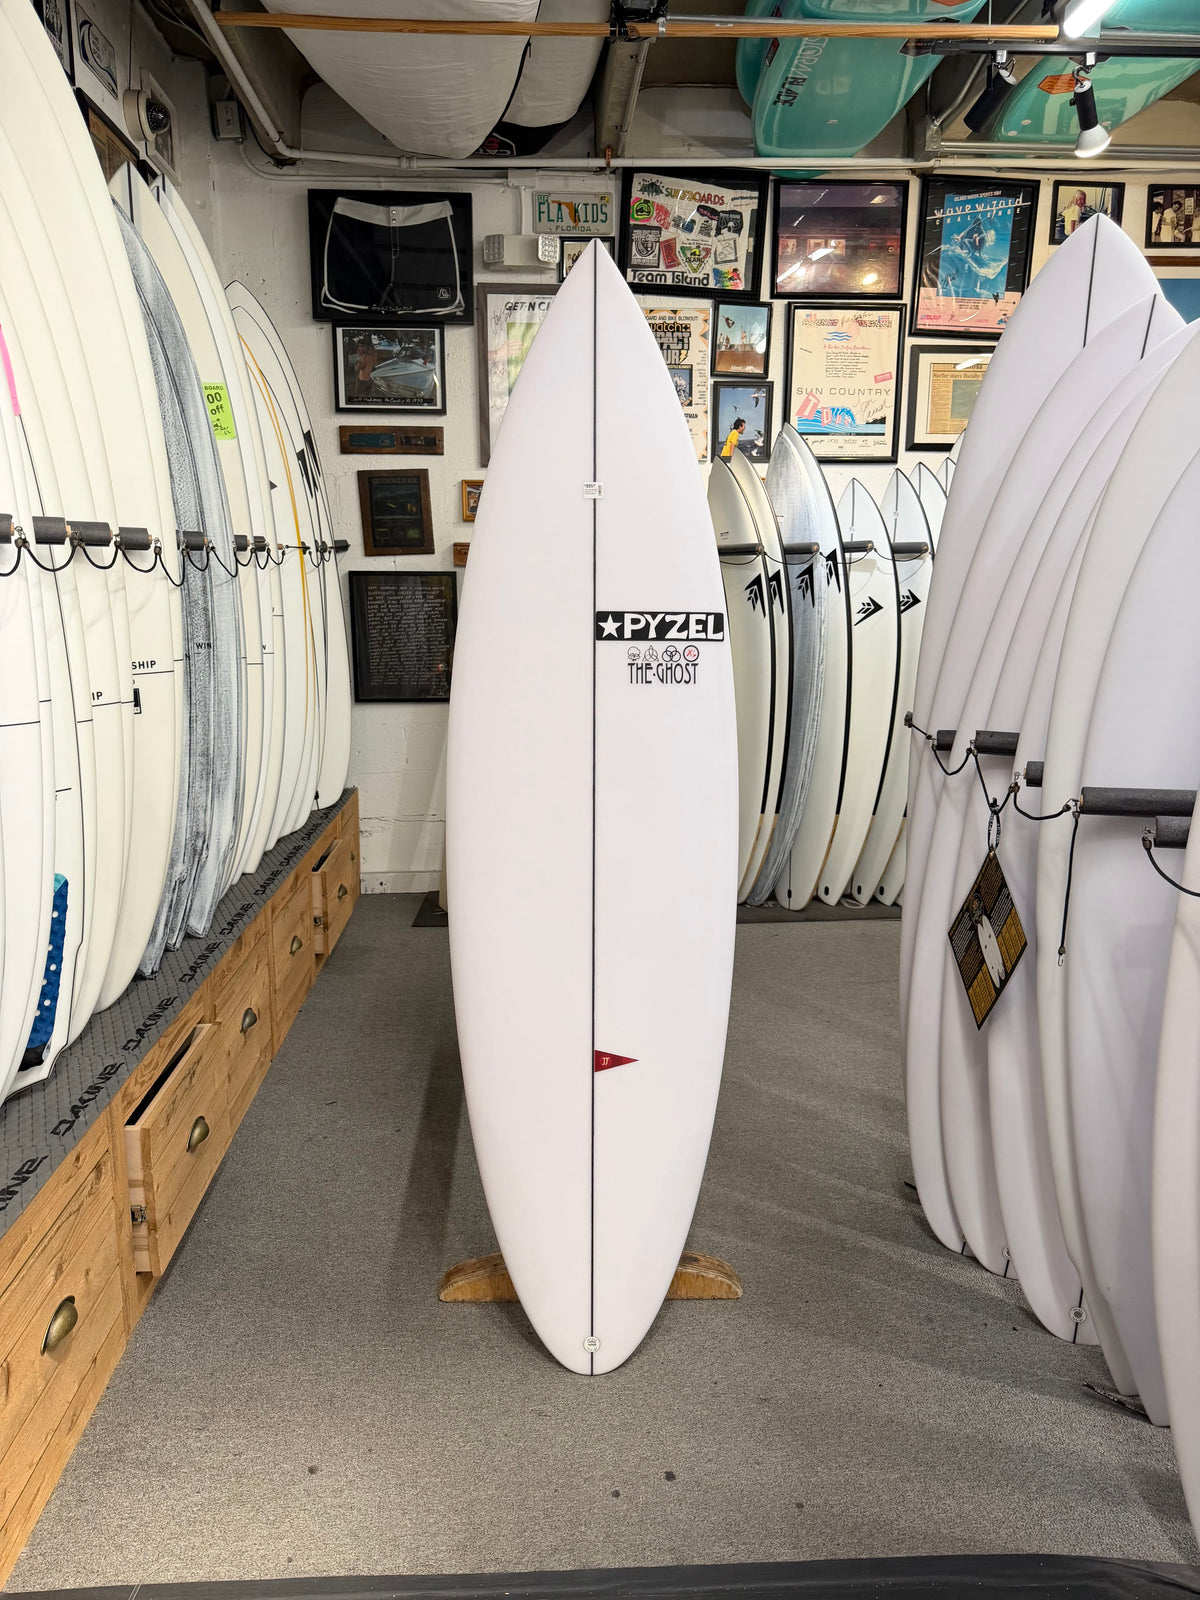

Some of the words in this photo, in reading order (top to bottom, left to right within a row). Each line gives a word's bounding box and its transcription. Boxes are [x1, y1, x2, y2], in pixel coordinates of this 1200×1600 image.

[538, 202, 564, 223] FLA
[573, 202, 608, 223] KIDS
[631, 269, 667, 283] Team
[671, 272, 710, 286] Island
[796, 387, 823, 395] SUN
[829, 387, 891, 396] COUNTRY
[211, 404, 225, 415] off
[623, 612, 724, 640] PYZEL
[131, 660, 156, 670] SHIP
[253, 869, 283, 897] DAKINE
[219, 902, 256, 936] DAKINE
[179, 940, 224, 984] DAKINE
[122, 995, 178, 1052] DAKINE
[50, 1061, 125, 1138] DAKINE
